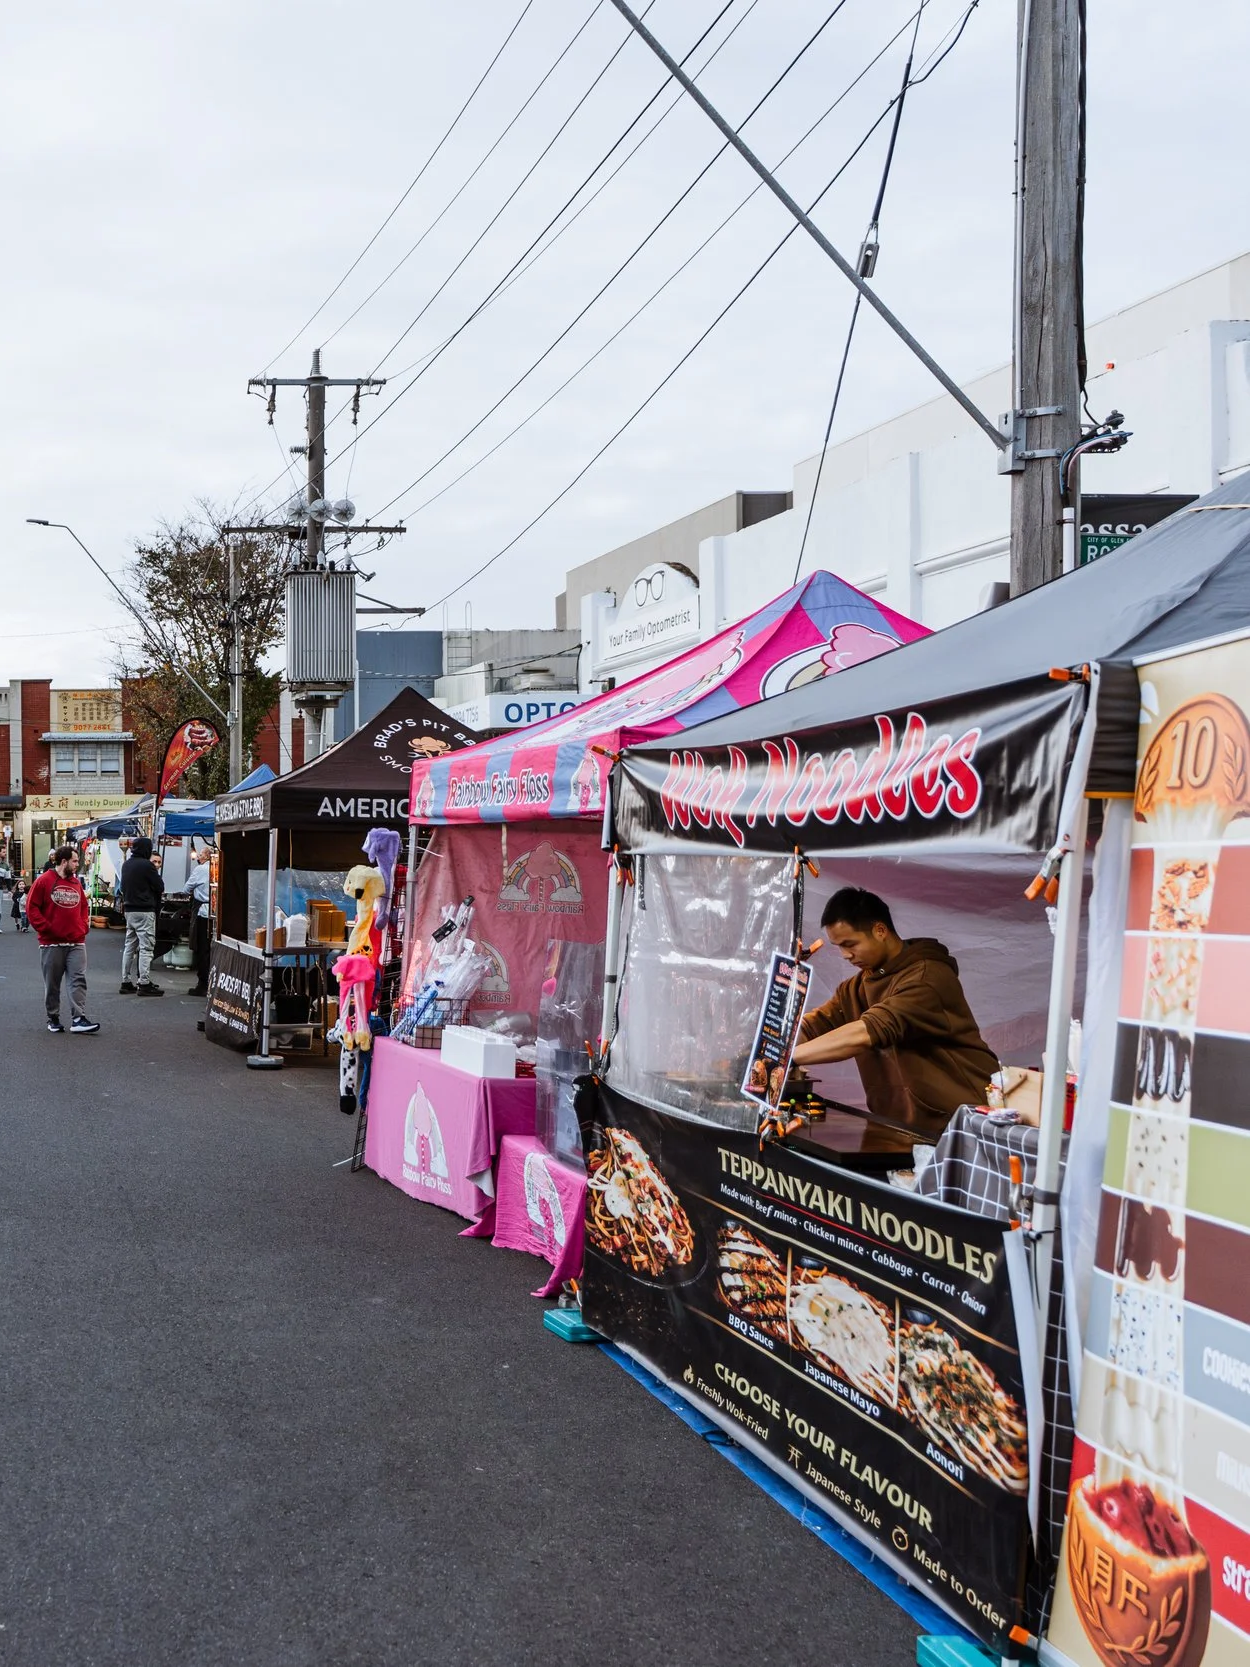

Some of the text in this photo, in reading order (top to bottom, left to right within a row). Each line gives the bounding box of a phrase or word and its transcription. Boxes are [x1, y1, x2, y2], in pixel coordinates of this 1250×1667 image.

[609, 610, 691, 647] Your Family Optometrist
[373, 718, 417, 748] BRAD'S
[422, 719, 450, 732] PIT
[1166, 716, 1218, 790] 10
[163, 769, 180, 791] German
[178, 751, 197, 769] Cuisine
[446, 768, 551, 809] Rainbow Fairy Floss
[746, 712, 982, 828] Noodles
[238, 798, 253, 819] STYLE
[253, 796, 264, 820] BBQ
[421, 1171, 437, 1189] Fairy
[717, 1147, 998, 1285] TEPPANYAKI NOODLES
[720, 1183, 739, 1201] Made
[755, 1198, 773, 1219] Beef
[773, 1206, 797, 1226] mince
[803, 1220, 835, 1243] Chicken
[837, 1235, 864, 1256] mince
[871, 1250, 913, 1278] Cabbage
[922, 1271, 955, 1297] Carrot
[960, 1290, 986, 1316] Onion
[727, 1313, 774, 1350] BBQ Sauce
[696, 1377, 769, 1441] Freshly Wok-Fried
[804, 1360, 881, 1417] Japanese Mayo
[714, 1362, 933, 1534] CHOOSE YOUR FLAVOUR
[926, 1442, 964, 1481] Aonori
[805, 1461, 881, 1529] Japanese Style
[913, 1544, 1007, 1630] Made to Order
